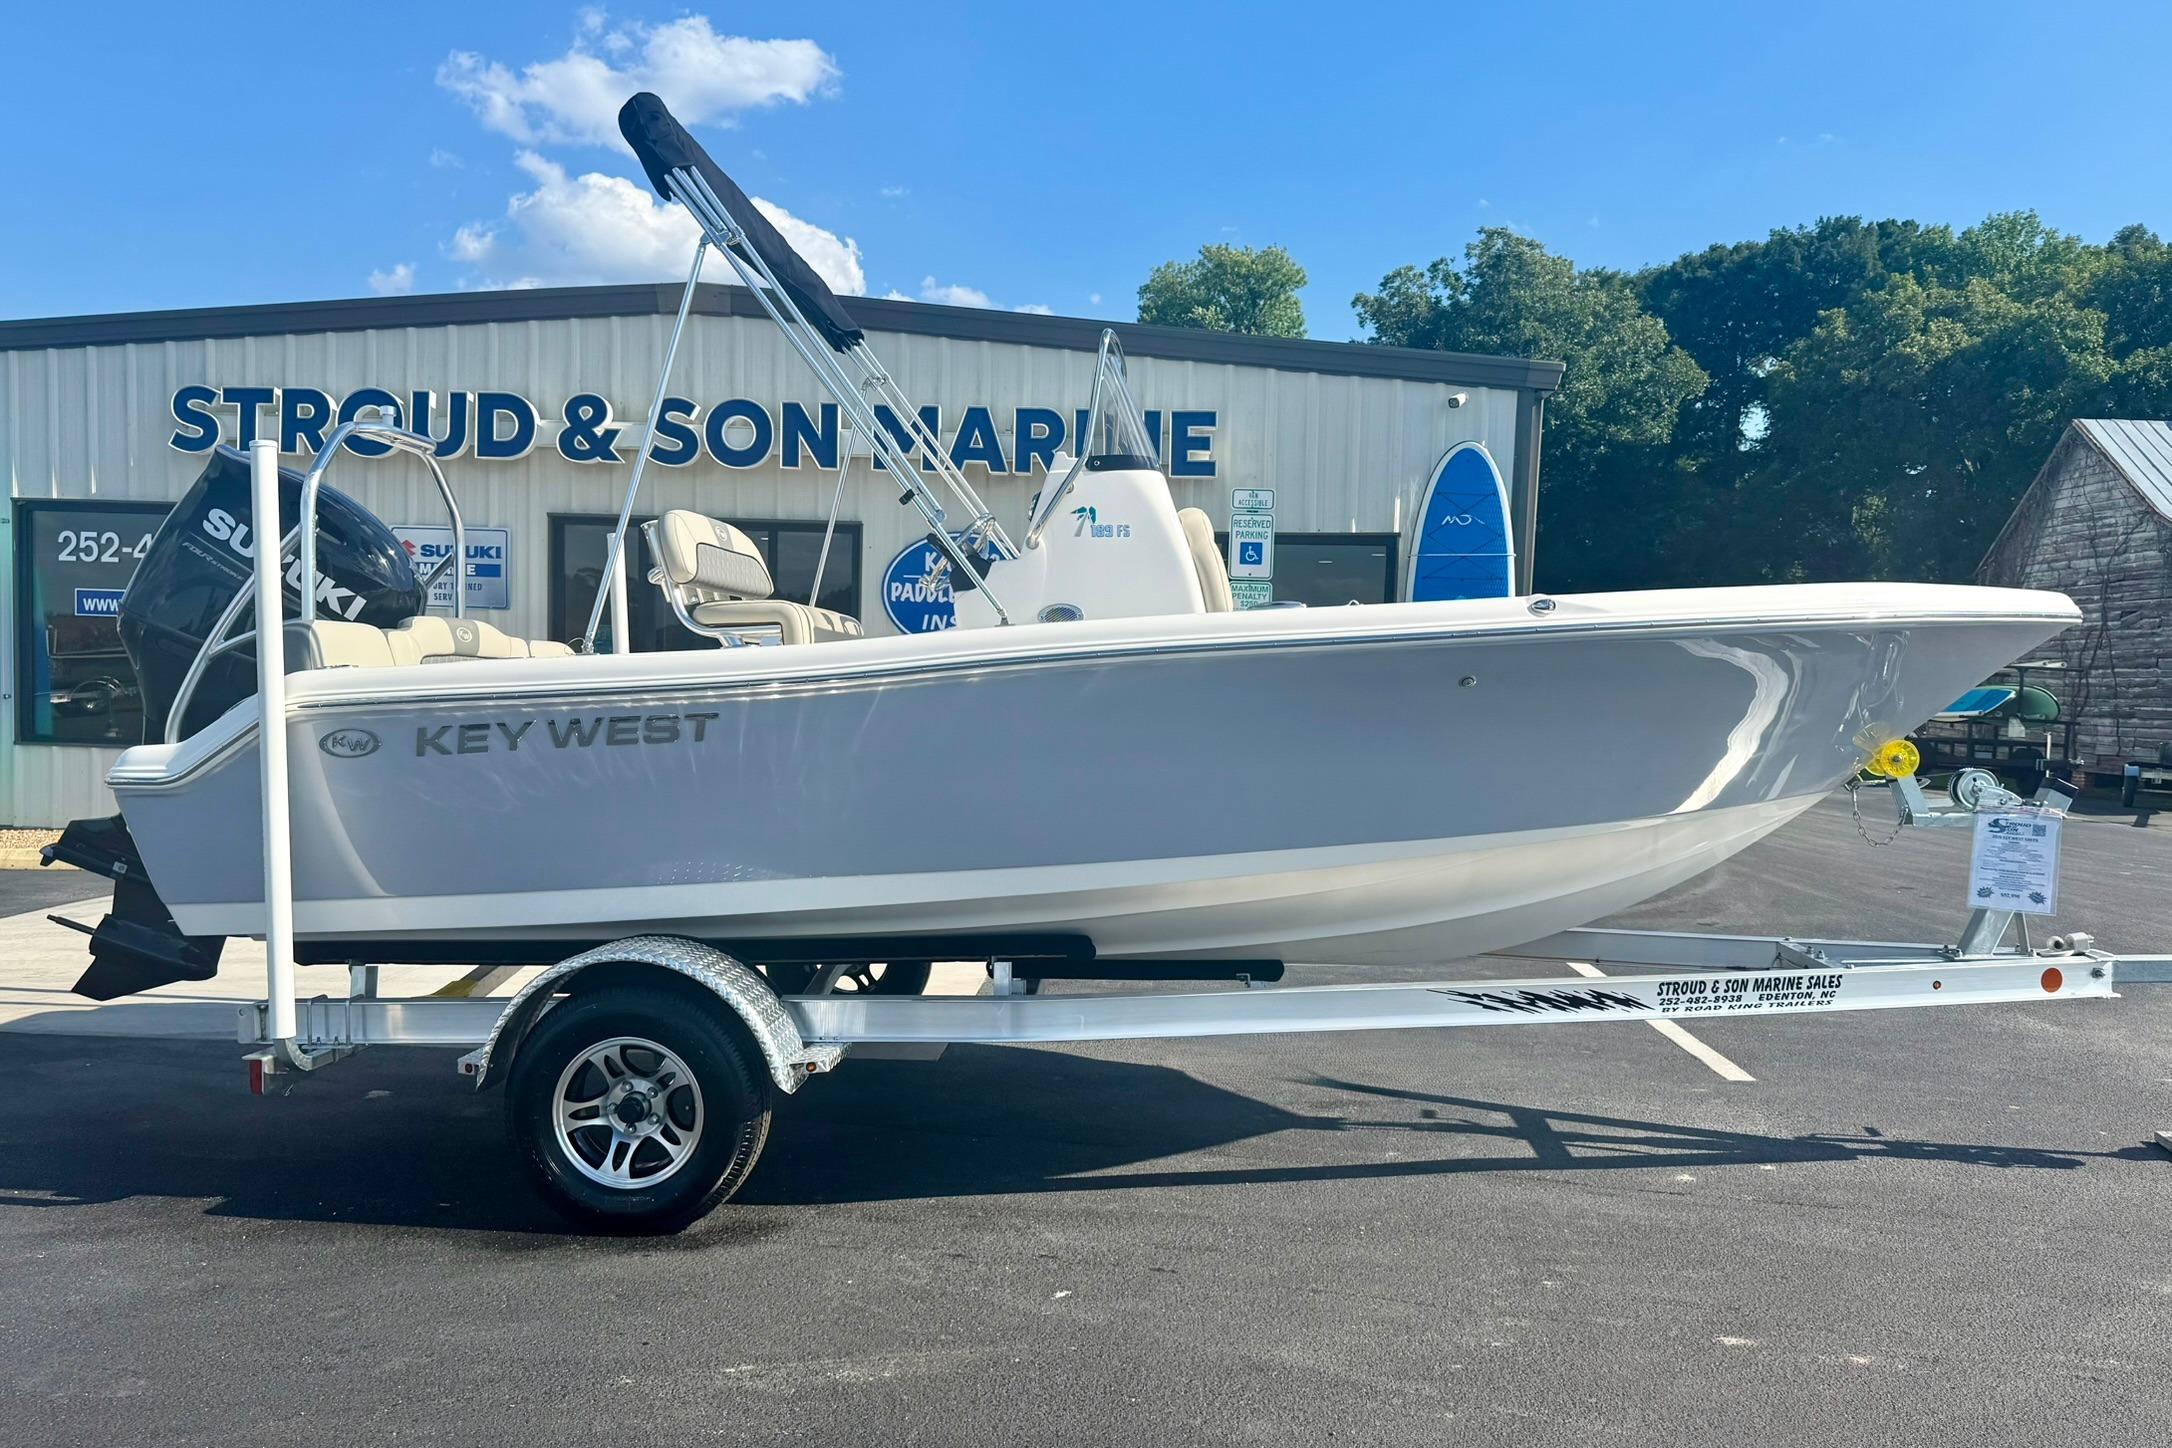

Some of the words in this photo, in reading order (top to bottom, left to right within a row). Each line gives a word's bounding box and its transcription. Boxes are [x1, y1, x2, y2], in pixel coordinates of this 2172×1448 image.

[168, 385, 540, 459] STROUD
[556, 392, 625, 464] &
[648, 396, 842, 471] SON
[872, 403, 1218, 478] MARINE
[1238, 499, 1268, 507] ACCESSIBLE
[1090, 524, 1114, 538] 189
[1116, 524, 1131, 538] FS
[1233, 519, 1272, 528] RESERVED
[1235, 530, 1269, 540] PARKING
[420, 543, 502, 559] SUUKI
[202, 507, 368, 622] SUUKI
[1231, 592, 1267, 600] PENALTY
[416, 719, 537, 757] KEY
[547, 712, 720, 749] WEST
[1656, 980, 1707, 997] STROUD
[1711, 979, 1720, 994] &
[1723, 978, 1750, 994] SON
[1752, 975, 1803, 993] MARINE
[1806, 974, 1843, 990] SALES
[1658, 994, 1743, 1006] 252-482-8938
[1758, 991, 1816, 1002] EDENTON,
[1820, 990, 1837, 998] NC
[1684, 1004, 1722, 1012] ROAD
[1728, 1002, 1763, 1010] KING
[1769, 999, 1834, 1008] TRAILERS
